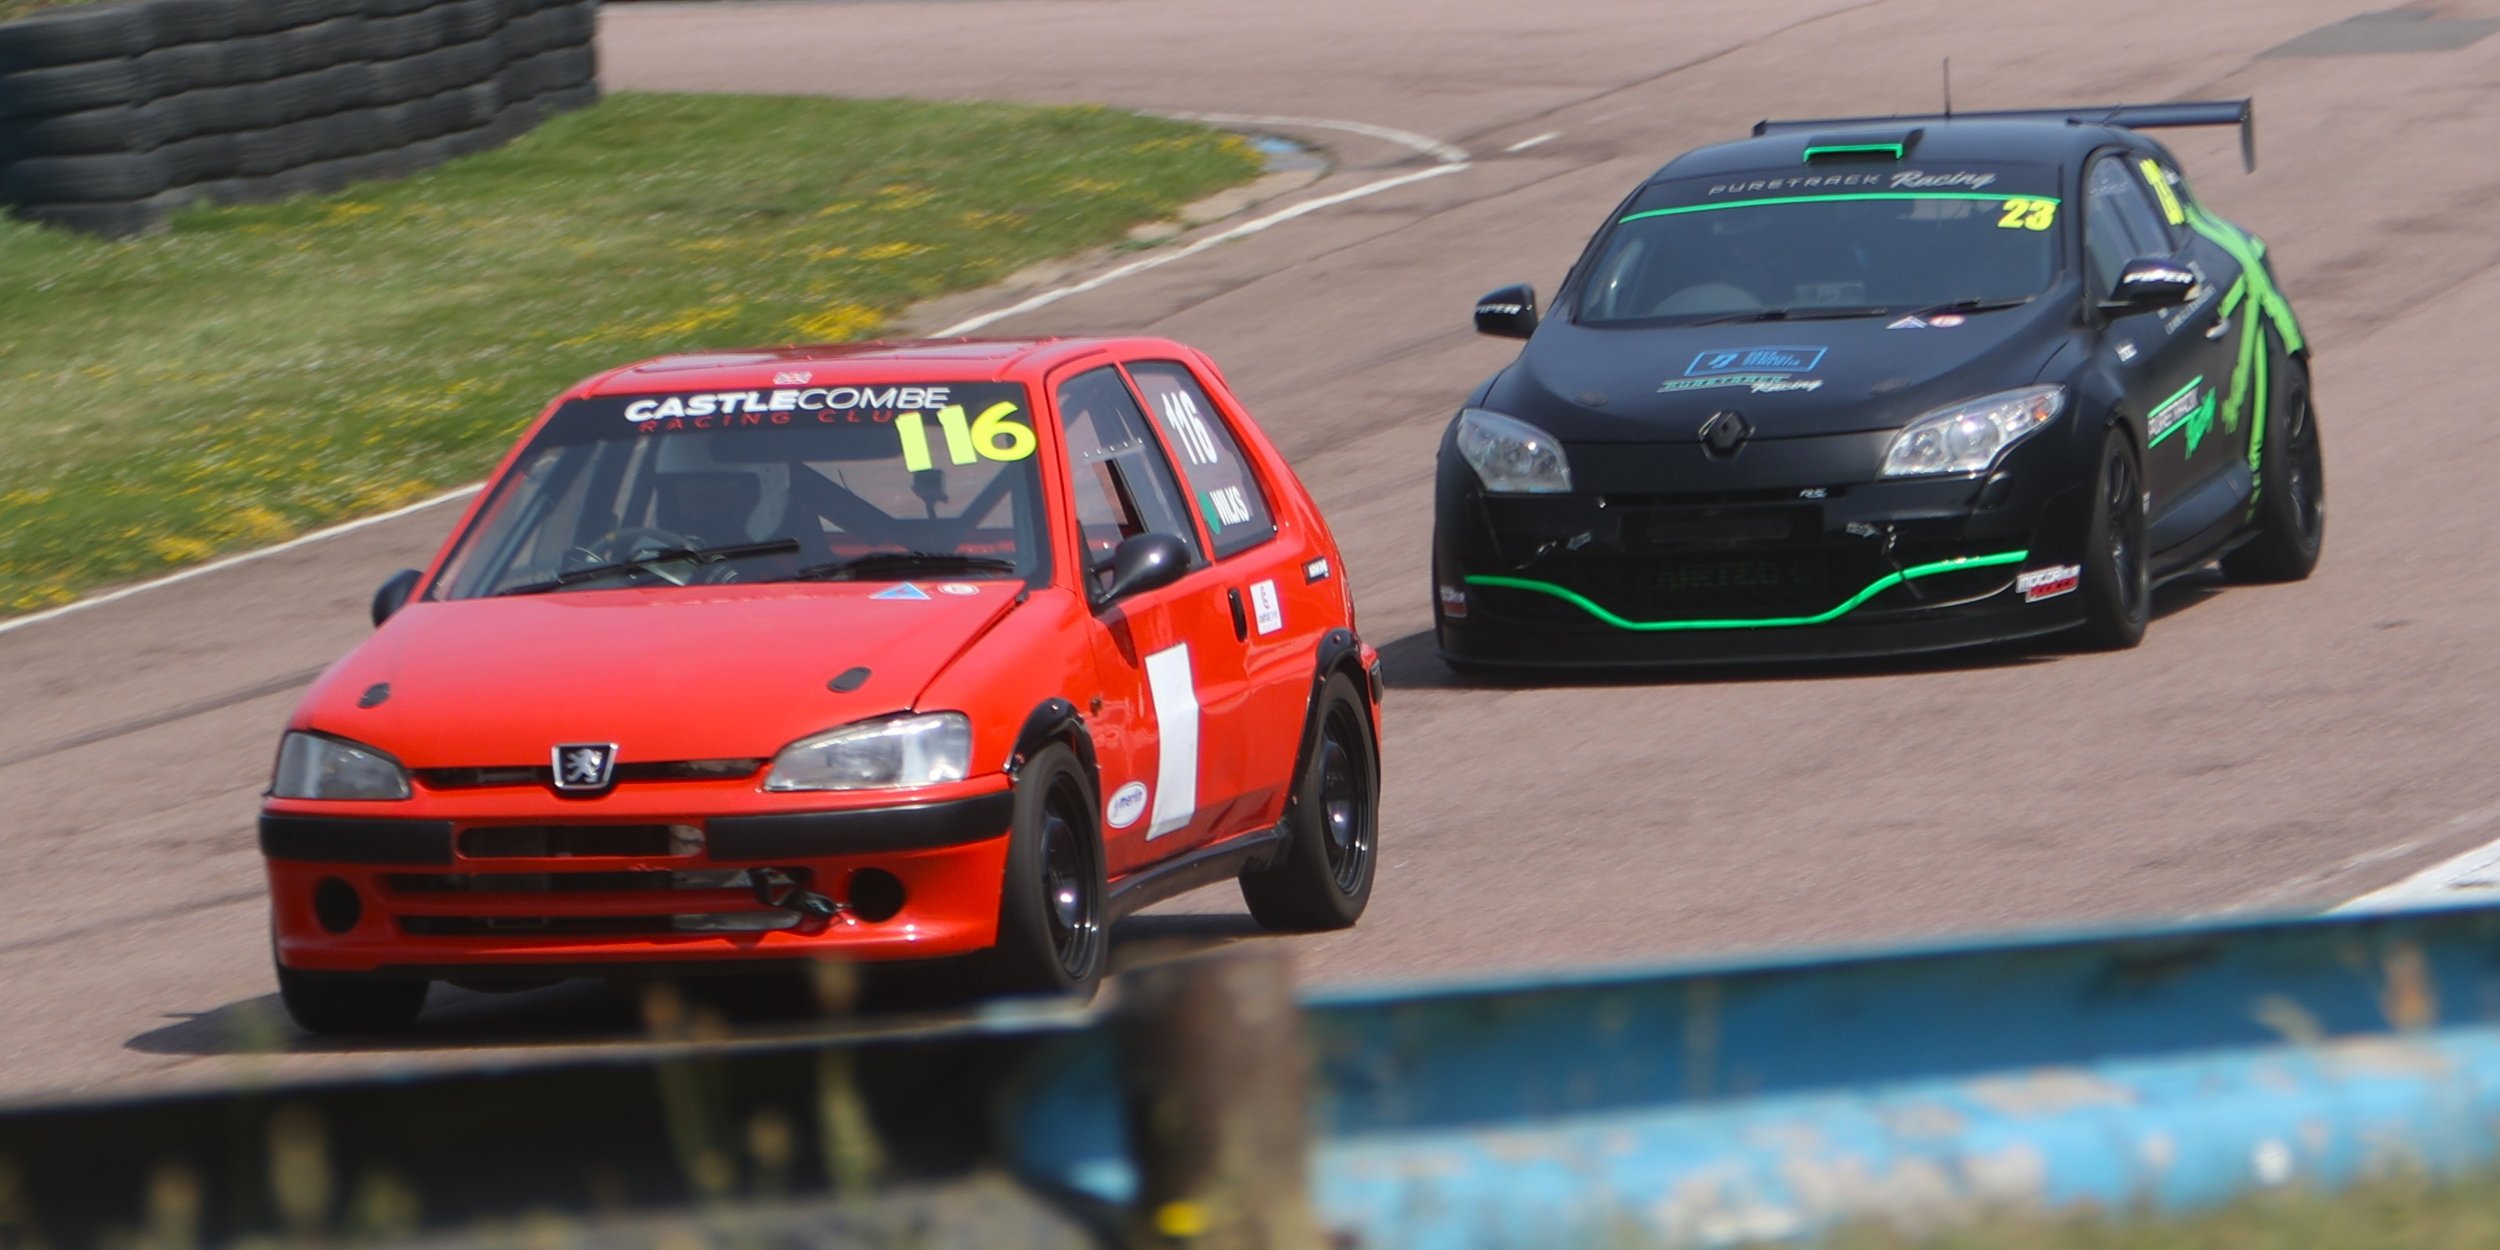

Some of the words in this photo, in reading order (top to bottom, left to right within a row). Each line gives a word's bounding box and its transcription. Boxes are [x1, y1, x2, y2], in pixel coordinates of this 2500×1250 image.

[1889, 170, 1997, 190] Racing
[1997, 197, 2056, 231] 23
[638, 411, 793, 434] RACING
[816, 408, 914, 424] CLU
[894, 400, 1037, 472] 116
[1160, 389, 1218, 466] 116
[1209, 486, 1250, 526] WILKS
